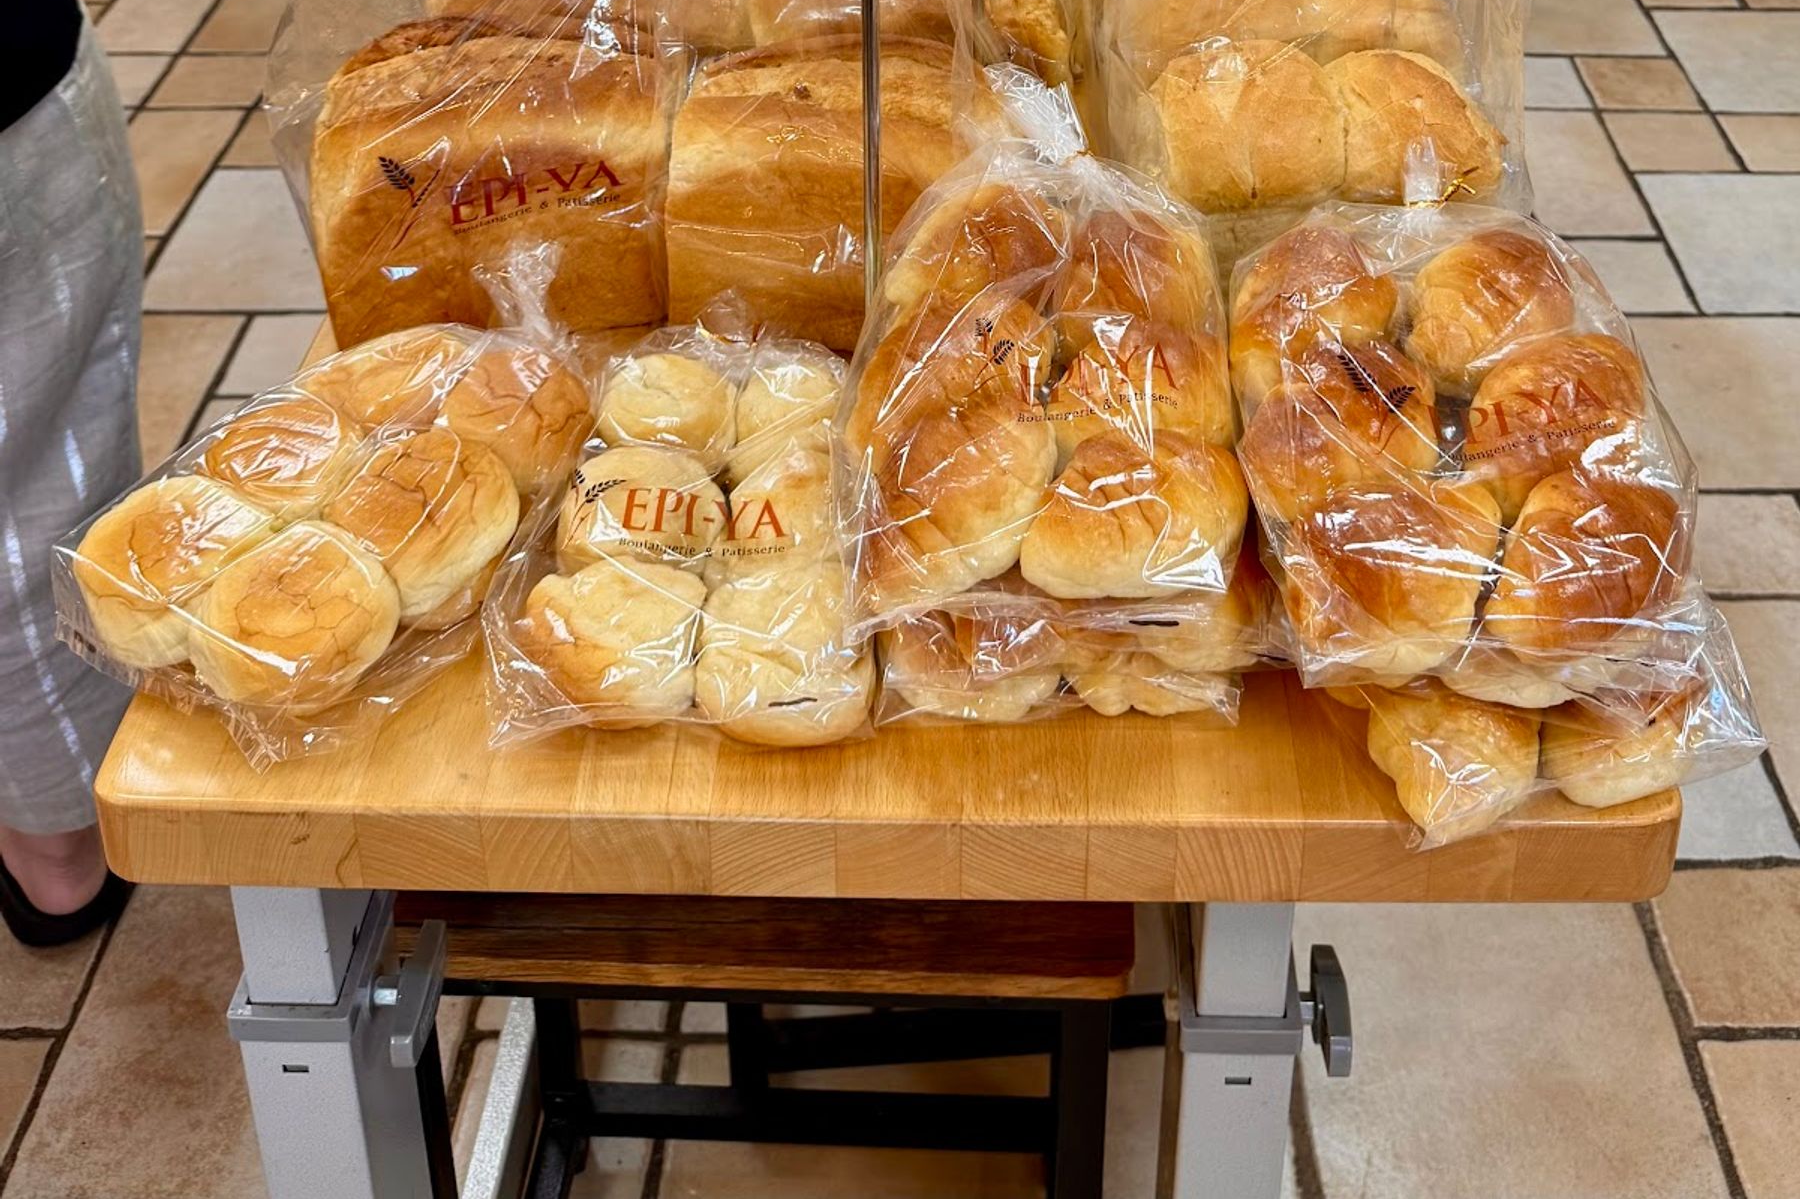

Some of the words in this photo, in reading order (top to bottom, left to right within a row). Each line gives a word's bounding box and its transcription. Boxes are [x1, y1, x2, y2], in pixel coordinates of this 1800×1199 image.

[446, 160, 626, 225] EPI-YA
[622, 488, 788, 541] EPI-YA
[618, 536, 696, 556] Boulangerie
[722, 543, 785, 557] Patisserie
